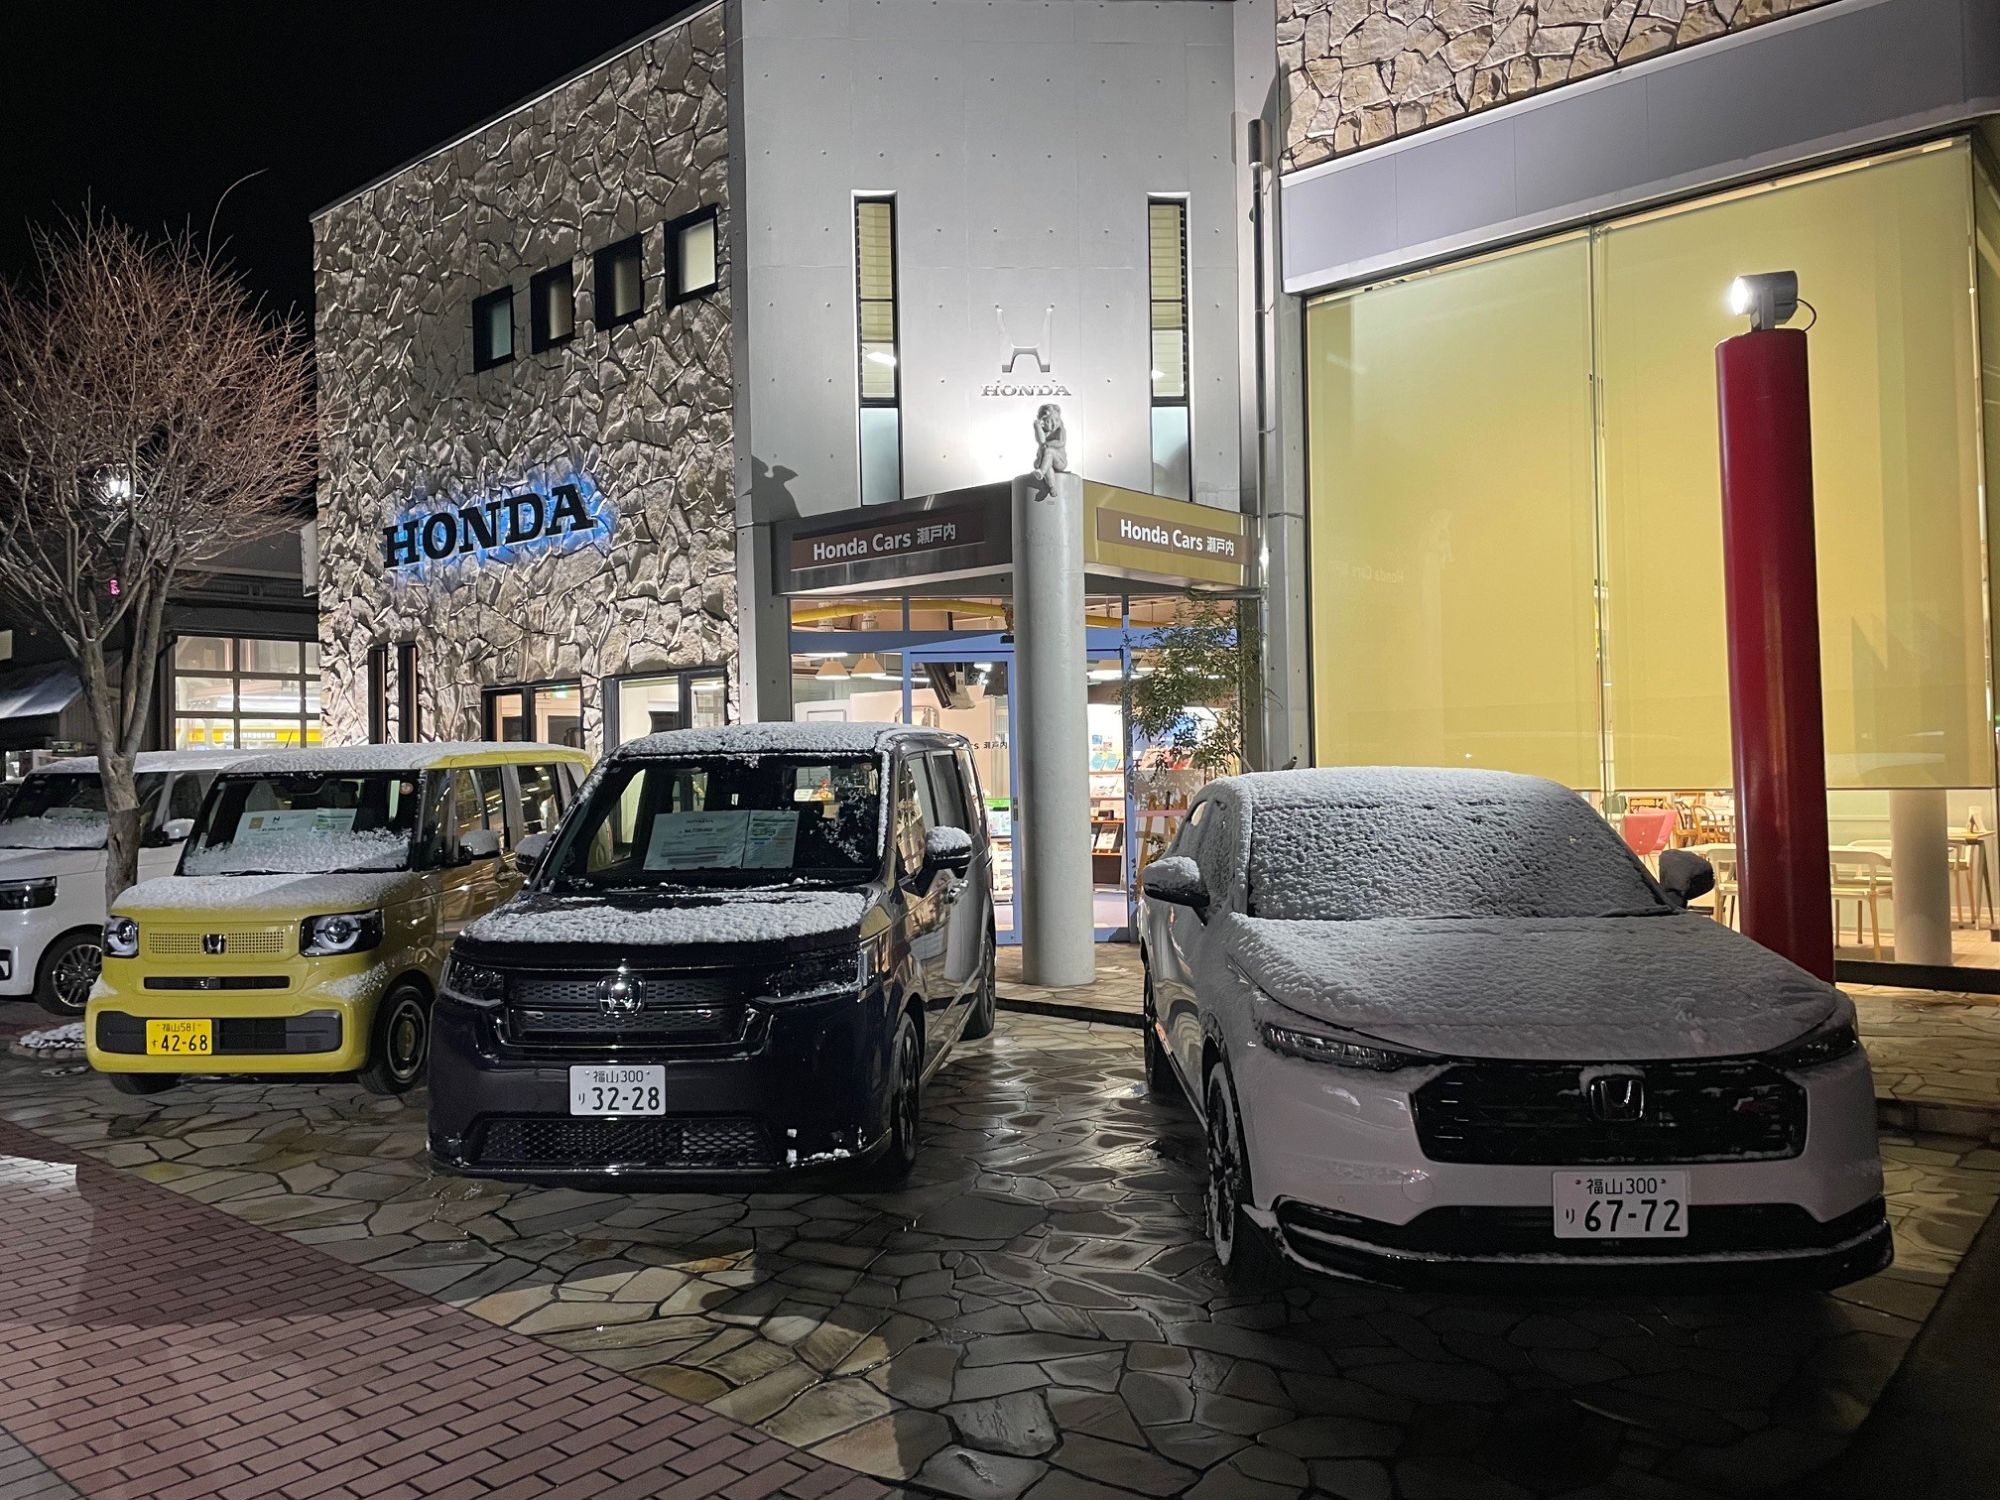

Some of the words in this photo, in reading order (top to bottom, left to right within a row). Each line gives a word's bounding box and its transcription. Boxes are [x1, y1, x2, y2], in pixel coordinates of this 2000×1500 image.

[981, 385, 1072, 397] HONDA
[382, 483, 597, 569] HONDA
[1120, 519, 1169, 545] Honda
[1172, 530, 1203, 551] Cars
[1206, 536, 1235, 557] 瀬戸内
[813, 537, 867, 561] Honda
[872, 533, 911, 552] Cars
[917, 522, 957, 545] 瀬戸内
[161, 1034, 207, 1051] 42-68
[592, 1086, 660, 1111] 32-28
[1586, 1178, 1658, 1195] 福山300
[1584, 1199, 1680, 1232] 67-72
